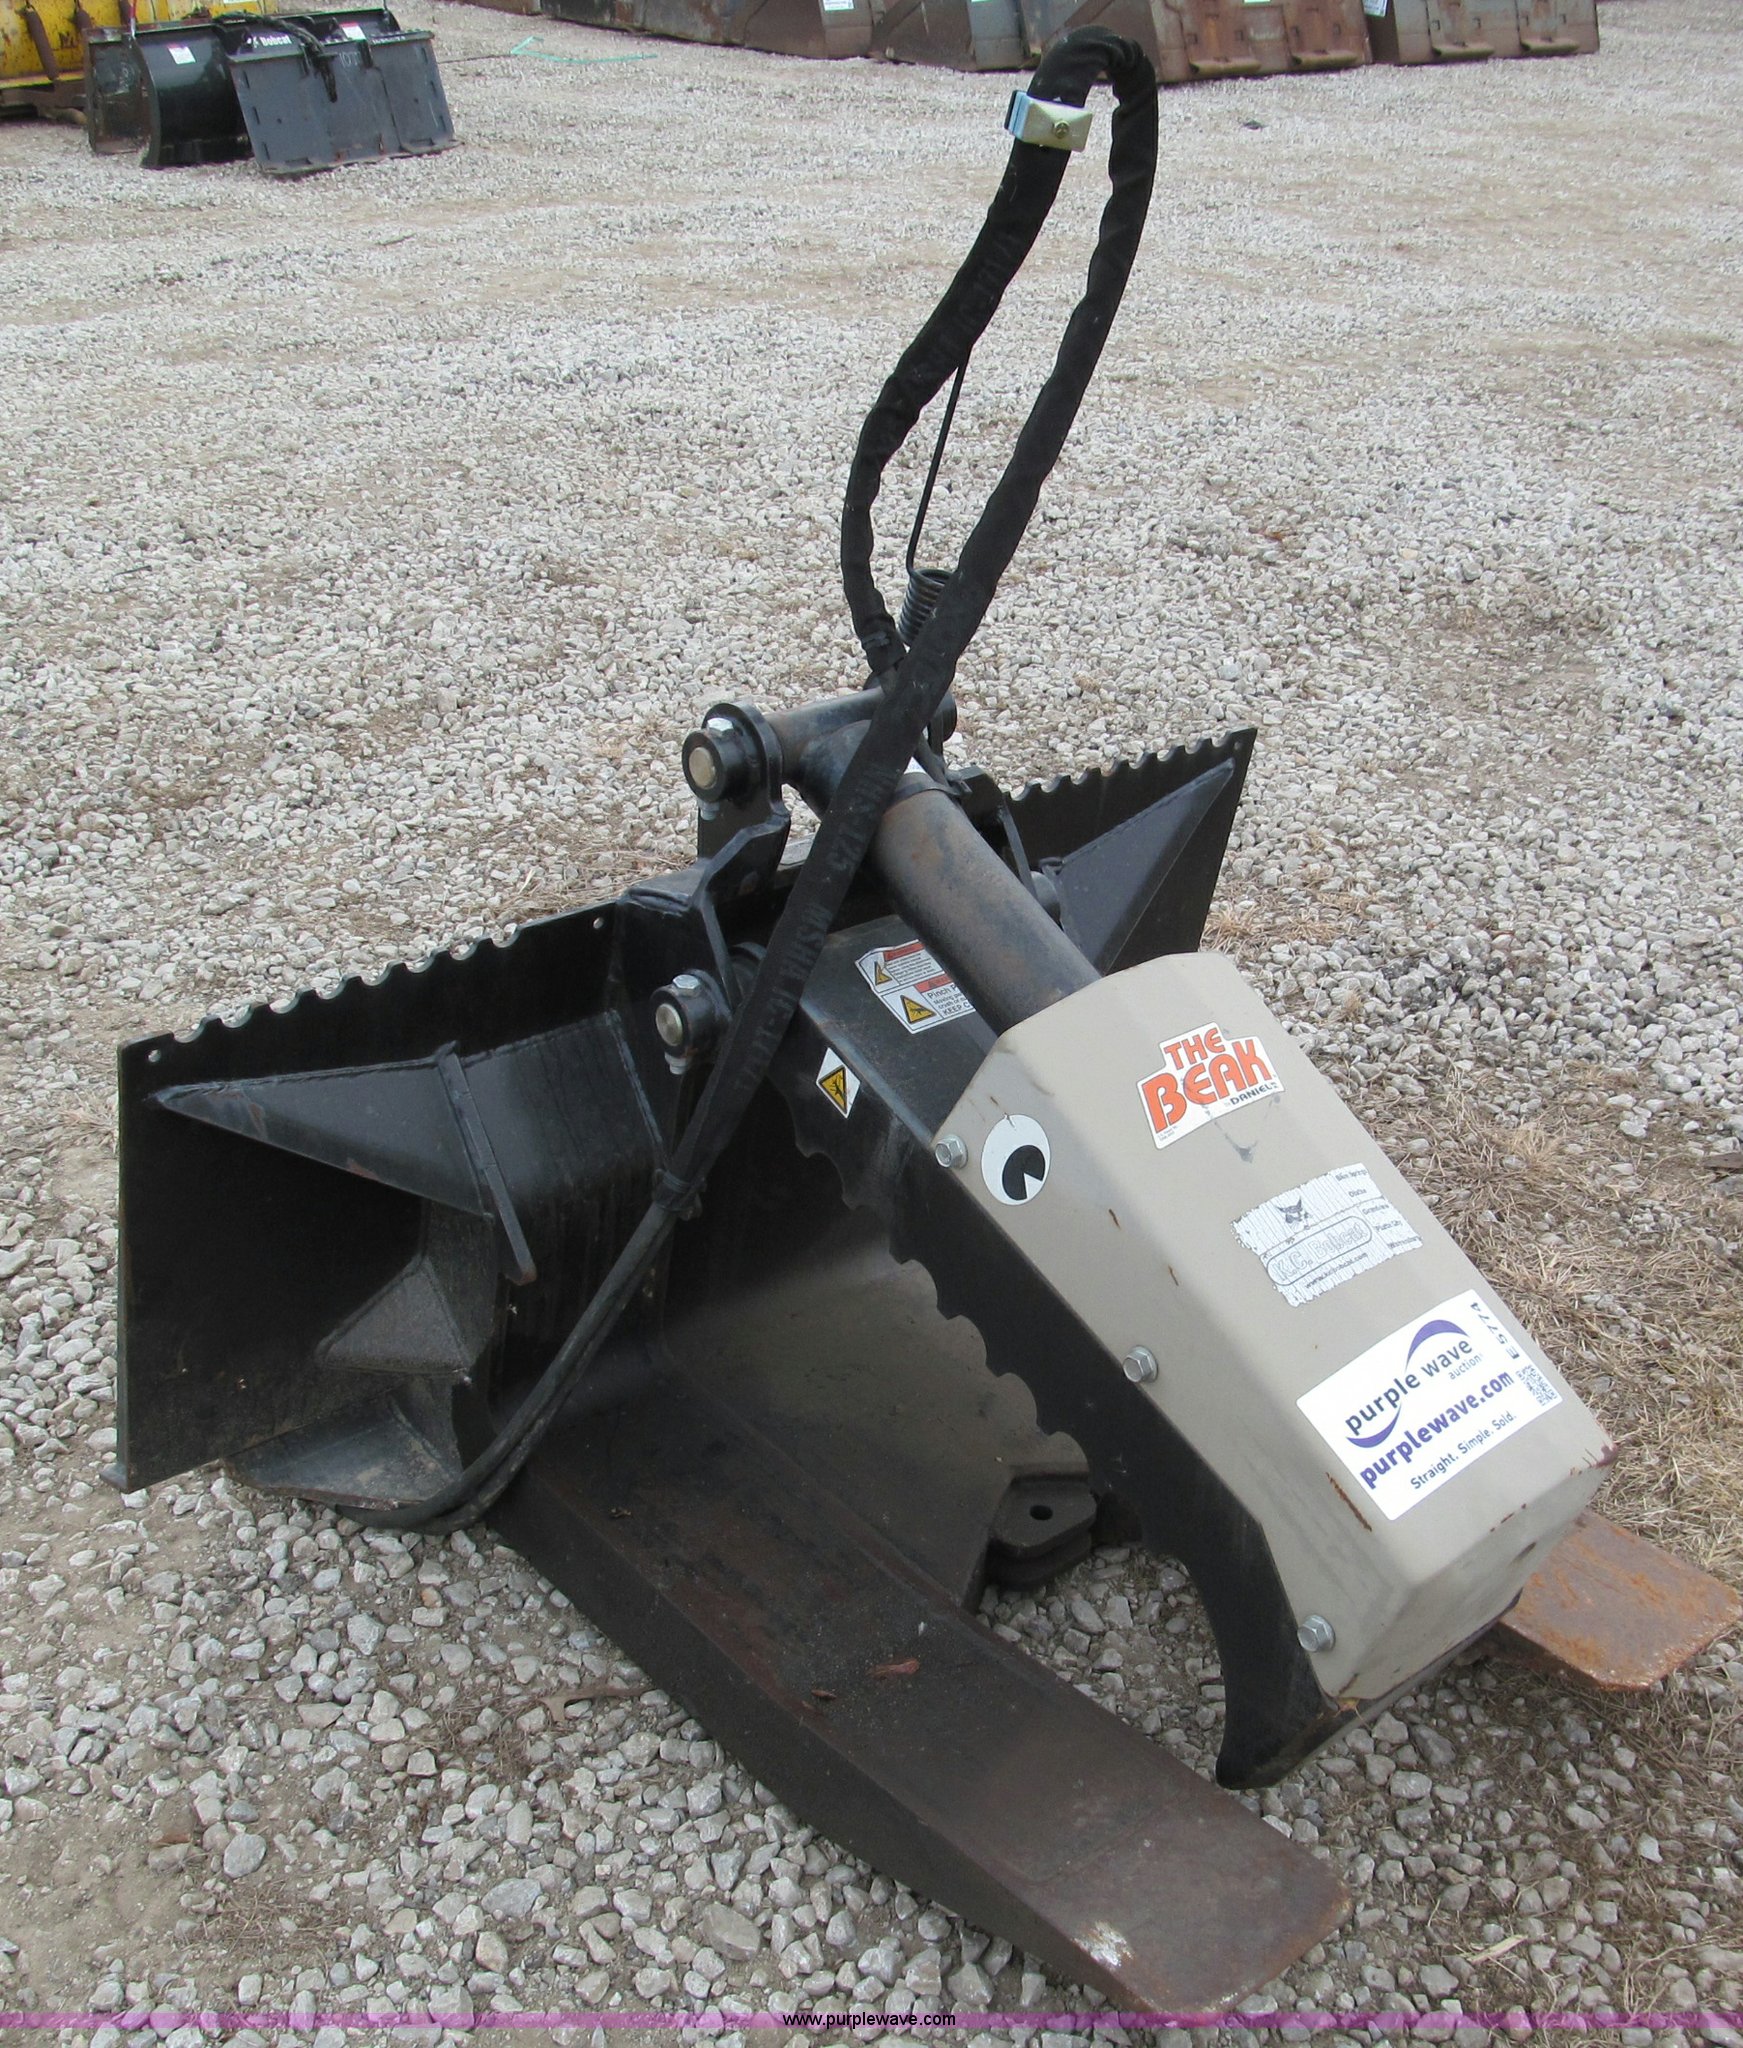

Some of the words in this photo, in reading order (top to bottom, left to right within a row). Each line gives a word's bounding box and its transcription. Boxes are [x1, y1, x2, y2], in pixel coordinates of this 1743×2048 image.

[259, 35, 292, 46] Bobcat
[927, 987, 951, 1000] Pinch
[942, 1005, 962, 1016] KEEP
[1163, 1027, 1226, 1071] THE
[1141, 1038, 1273, 1134] BEAK
[1307, 1222, 1368, 1260] Bobcat
[1448, 1353, 1482, 1380] auction
[1345, 1373, 1421, 1436] purple
[1420, 1340, 1473, 1378] wave
[1359, 1371, 1515, 1490] purplewave.com
[1410, 1452, 1459, 1490] Straight.
[1457, 1427, 1494, 1454] Simple.
[1491, 1410, 1517, 1430] Sold.
